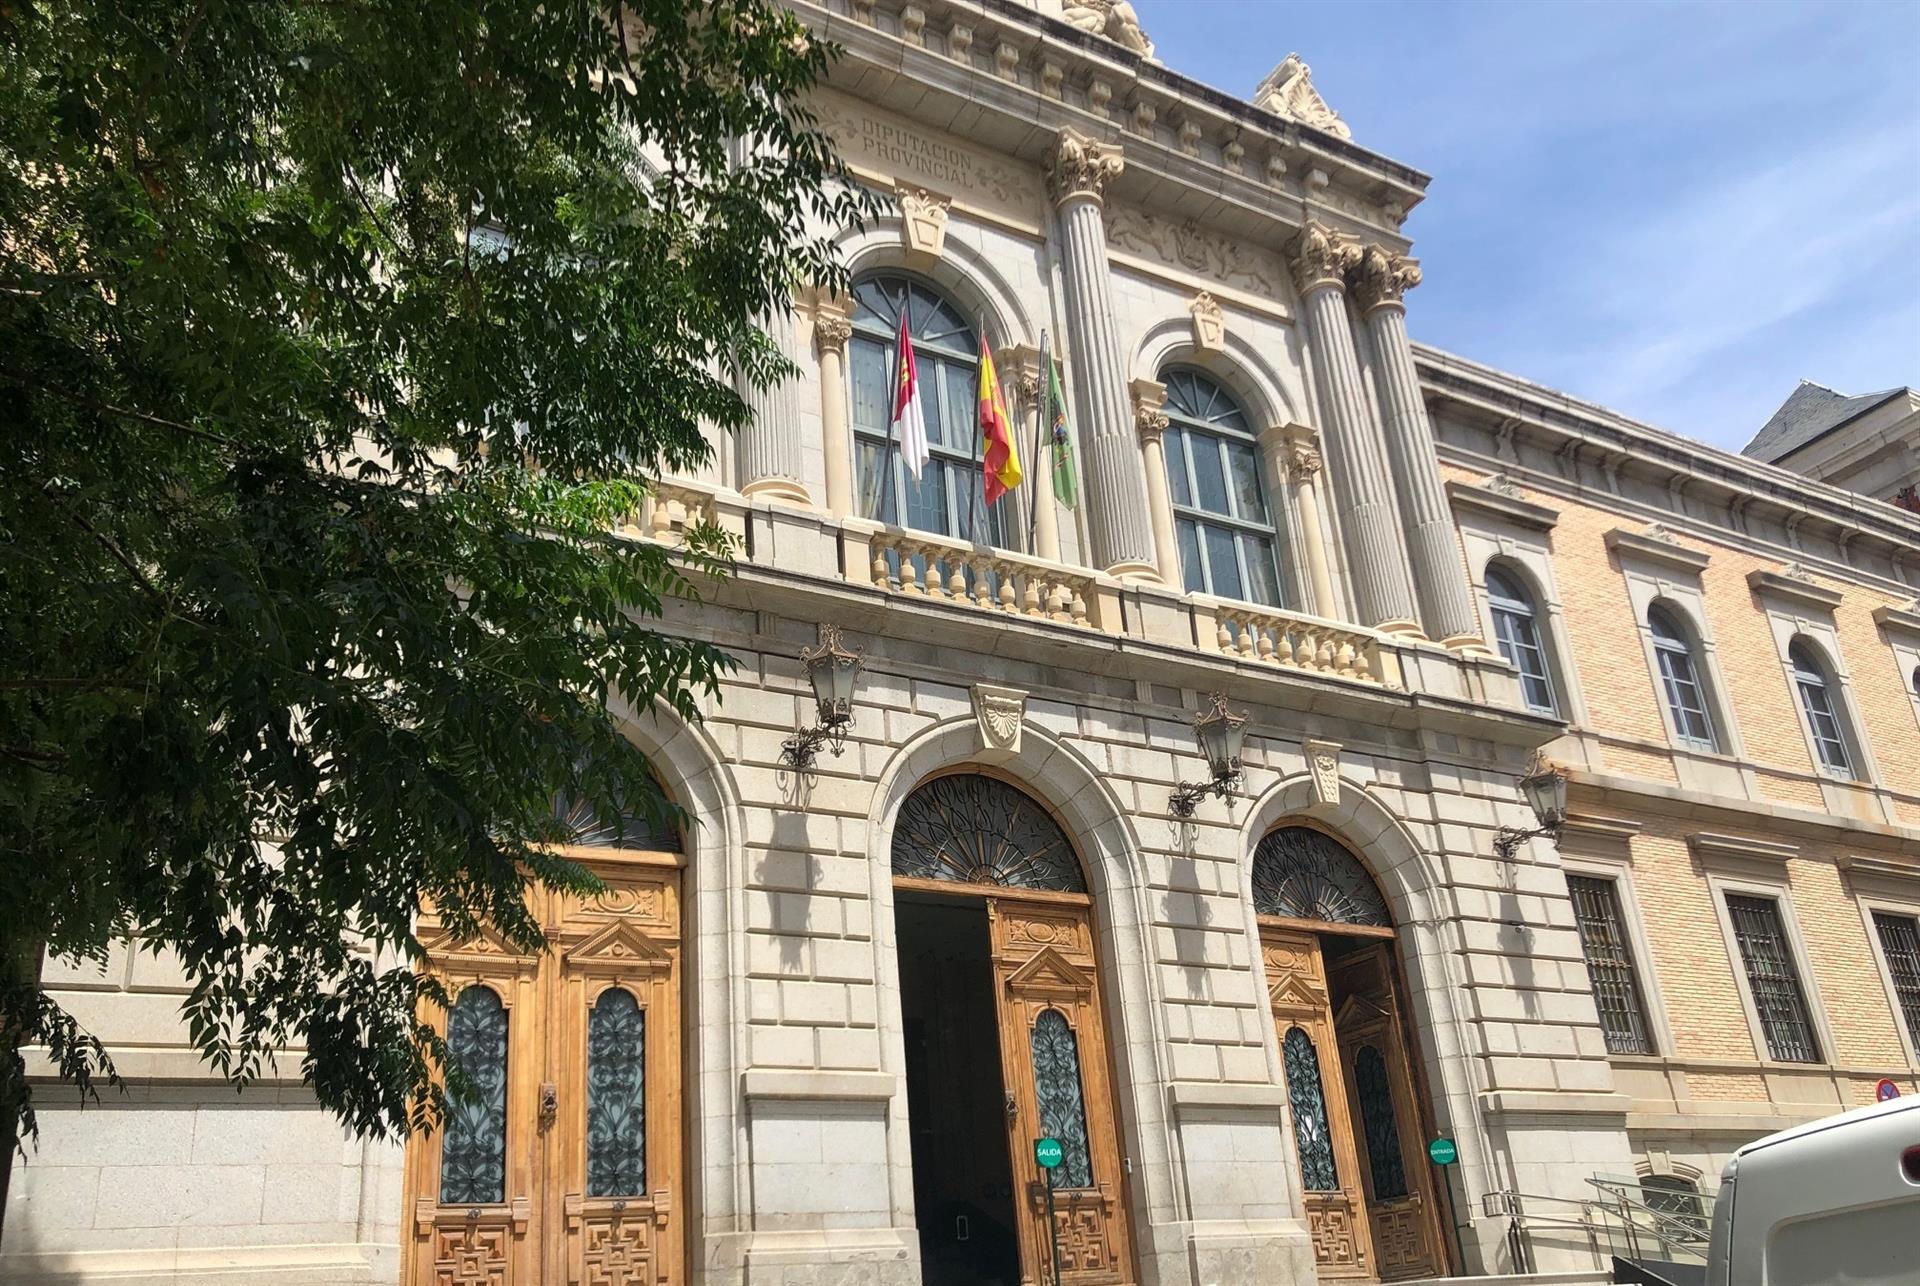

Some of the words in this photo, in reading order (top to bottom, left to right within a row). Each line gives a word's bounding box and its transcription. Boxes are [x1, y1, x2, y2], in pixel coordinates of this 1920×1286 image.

[862, 118, 972, 170] DIPUTACION
[863, 137, 974, 189] PROVINCIAL
[1037, 1148, 1062, 1157] SALIDA
